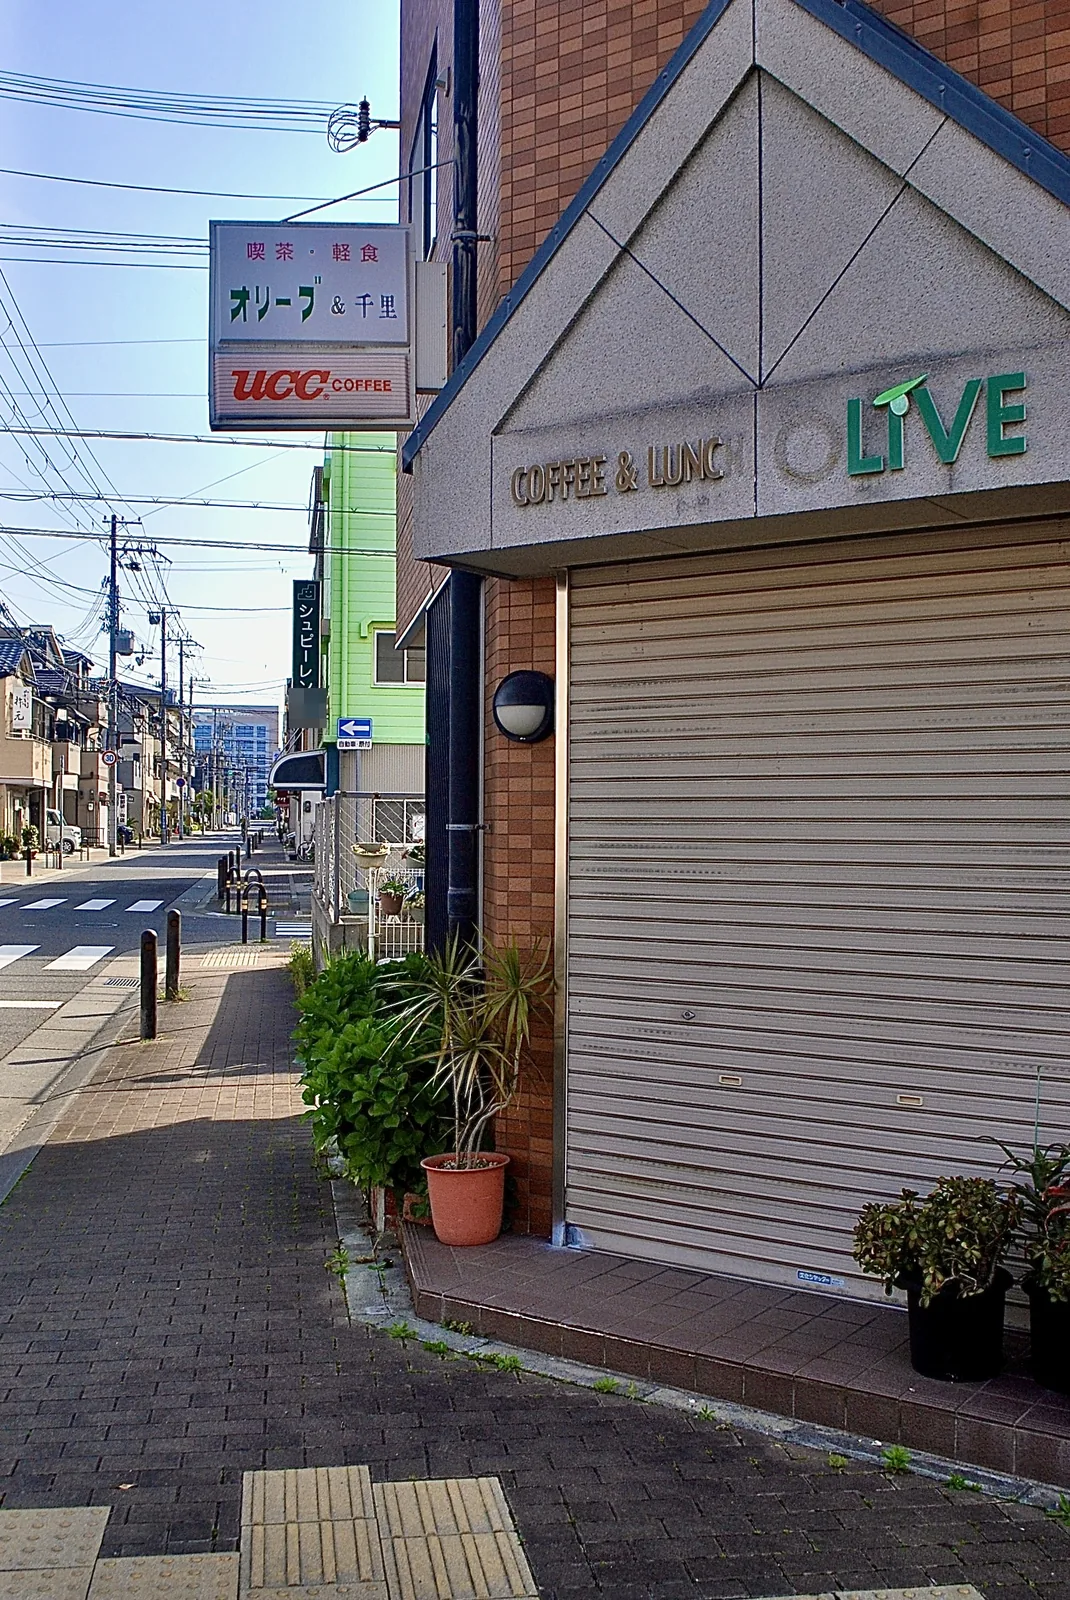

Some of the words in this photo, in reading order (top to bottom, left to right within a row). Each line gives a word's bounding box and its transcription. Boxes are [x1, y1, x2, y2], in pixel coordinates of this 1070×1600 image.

[247, 242, 379, 263] 喫茶・軽食
[230, 276, 322, 323] オリーブ
[330, 295, 346, 315] &
[355, 293, 398, 319] 千里
[332, 378, 392, 392] COFFEE
[511, 455, 607, 506] COFFEE
[615, 450, 638, 492] &
[104, 754, 114, 762] 30
